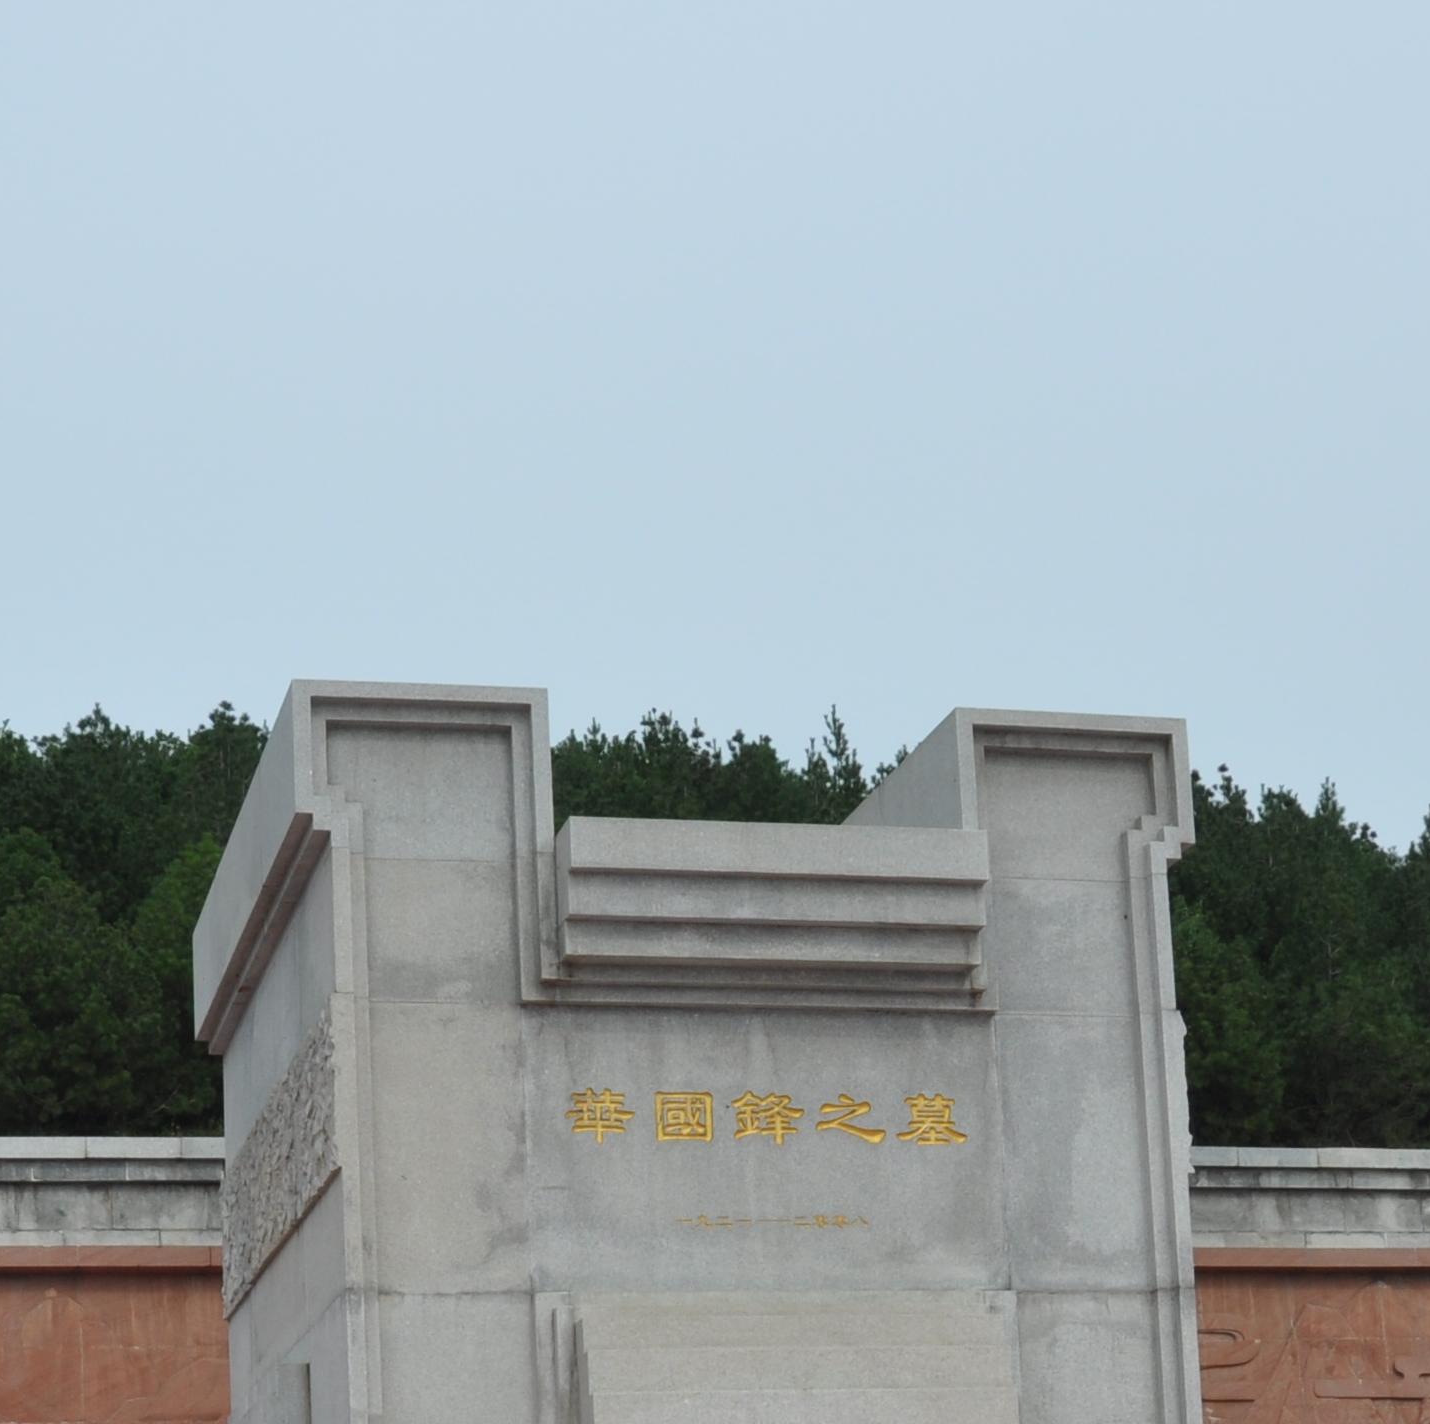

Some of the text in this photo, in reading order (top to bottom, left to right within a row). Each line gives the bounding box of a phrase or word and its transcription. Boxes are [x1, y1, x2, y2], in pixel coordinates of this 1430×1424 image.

[565, 1087, 968, 1145] 華國鋒之墓
